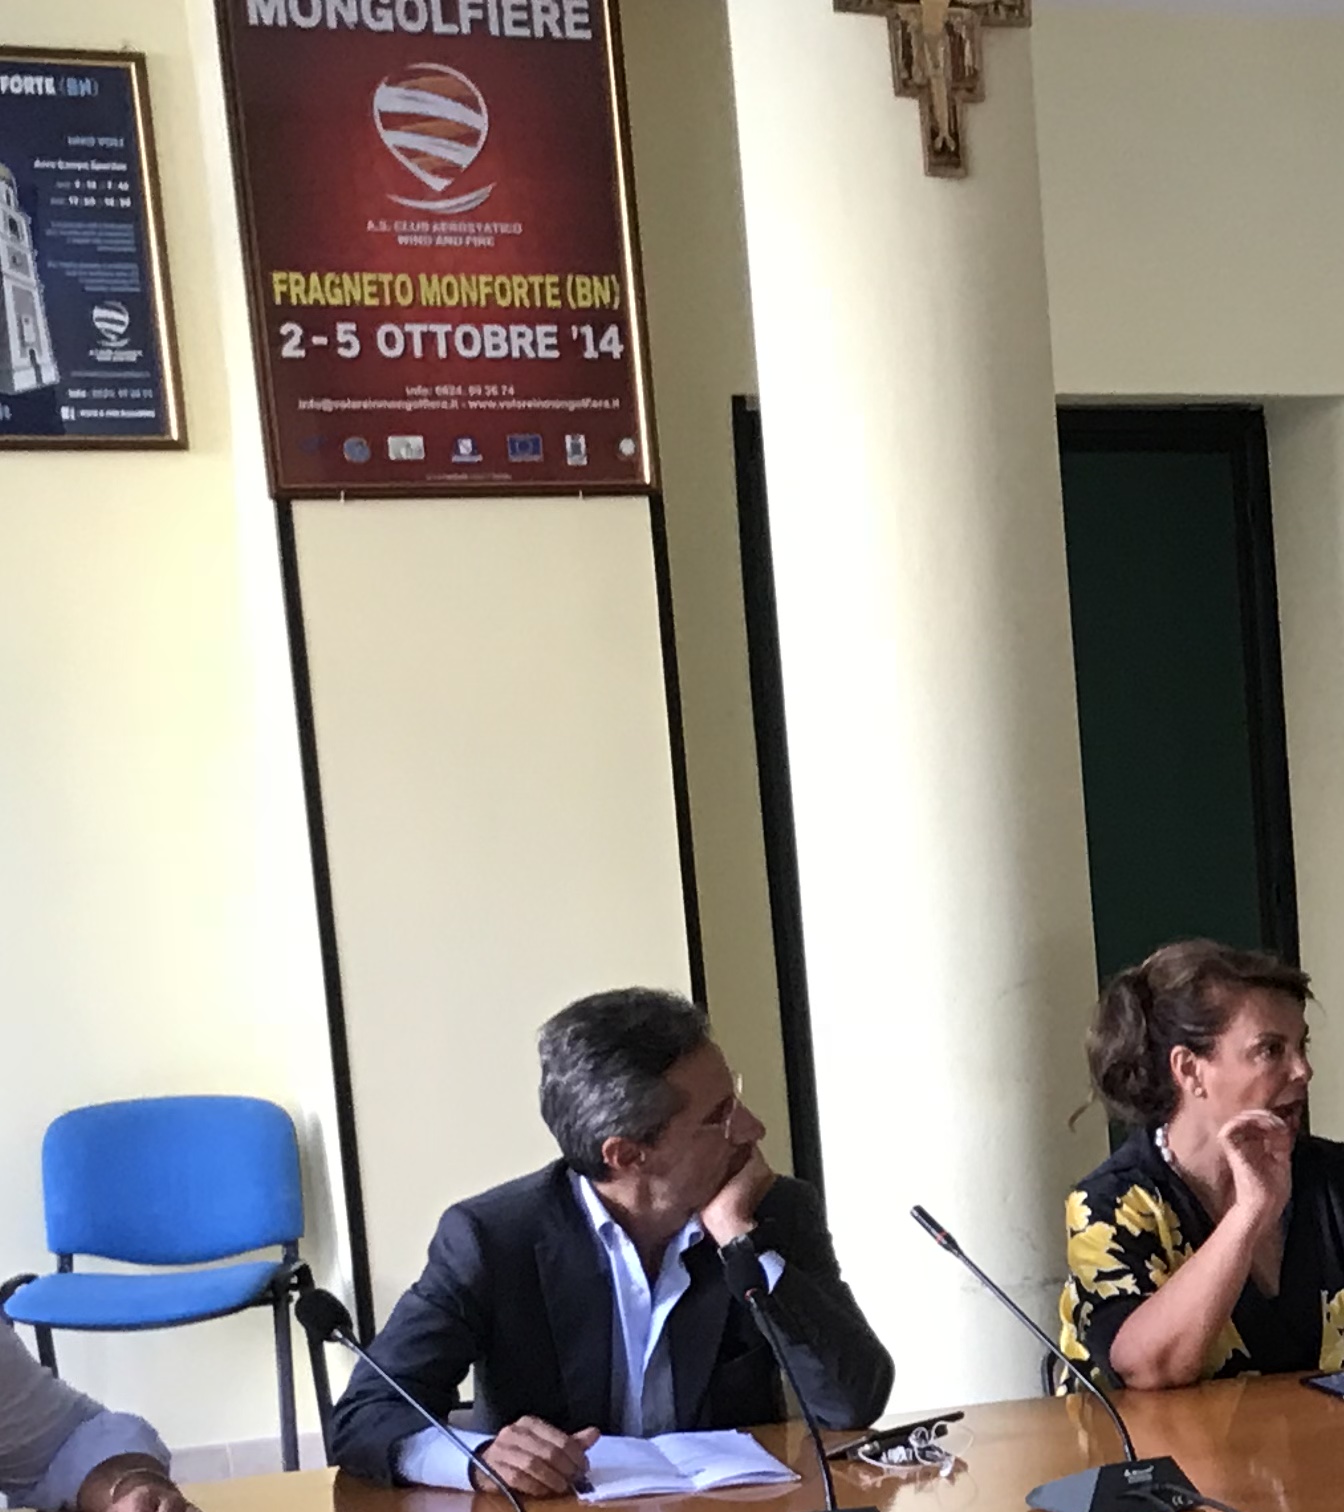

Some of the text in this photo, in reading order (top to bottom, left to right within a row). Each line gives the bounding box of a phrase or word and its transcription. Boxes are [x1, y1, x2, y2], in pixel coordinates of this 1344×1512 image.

[248, 0, 592, 40] MONGOLFIERE
[272, 272, 621, 310] FRAGNETO MONFORTE (BN)
[376, 322, 560, 359] OTTOBRE
[571, 323, 624, 359] '14
